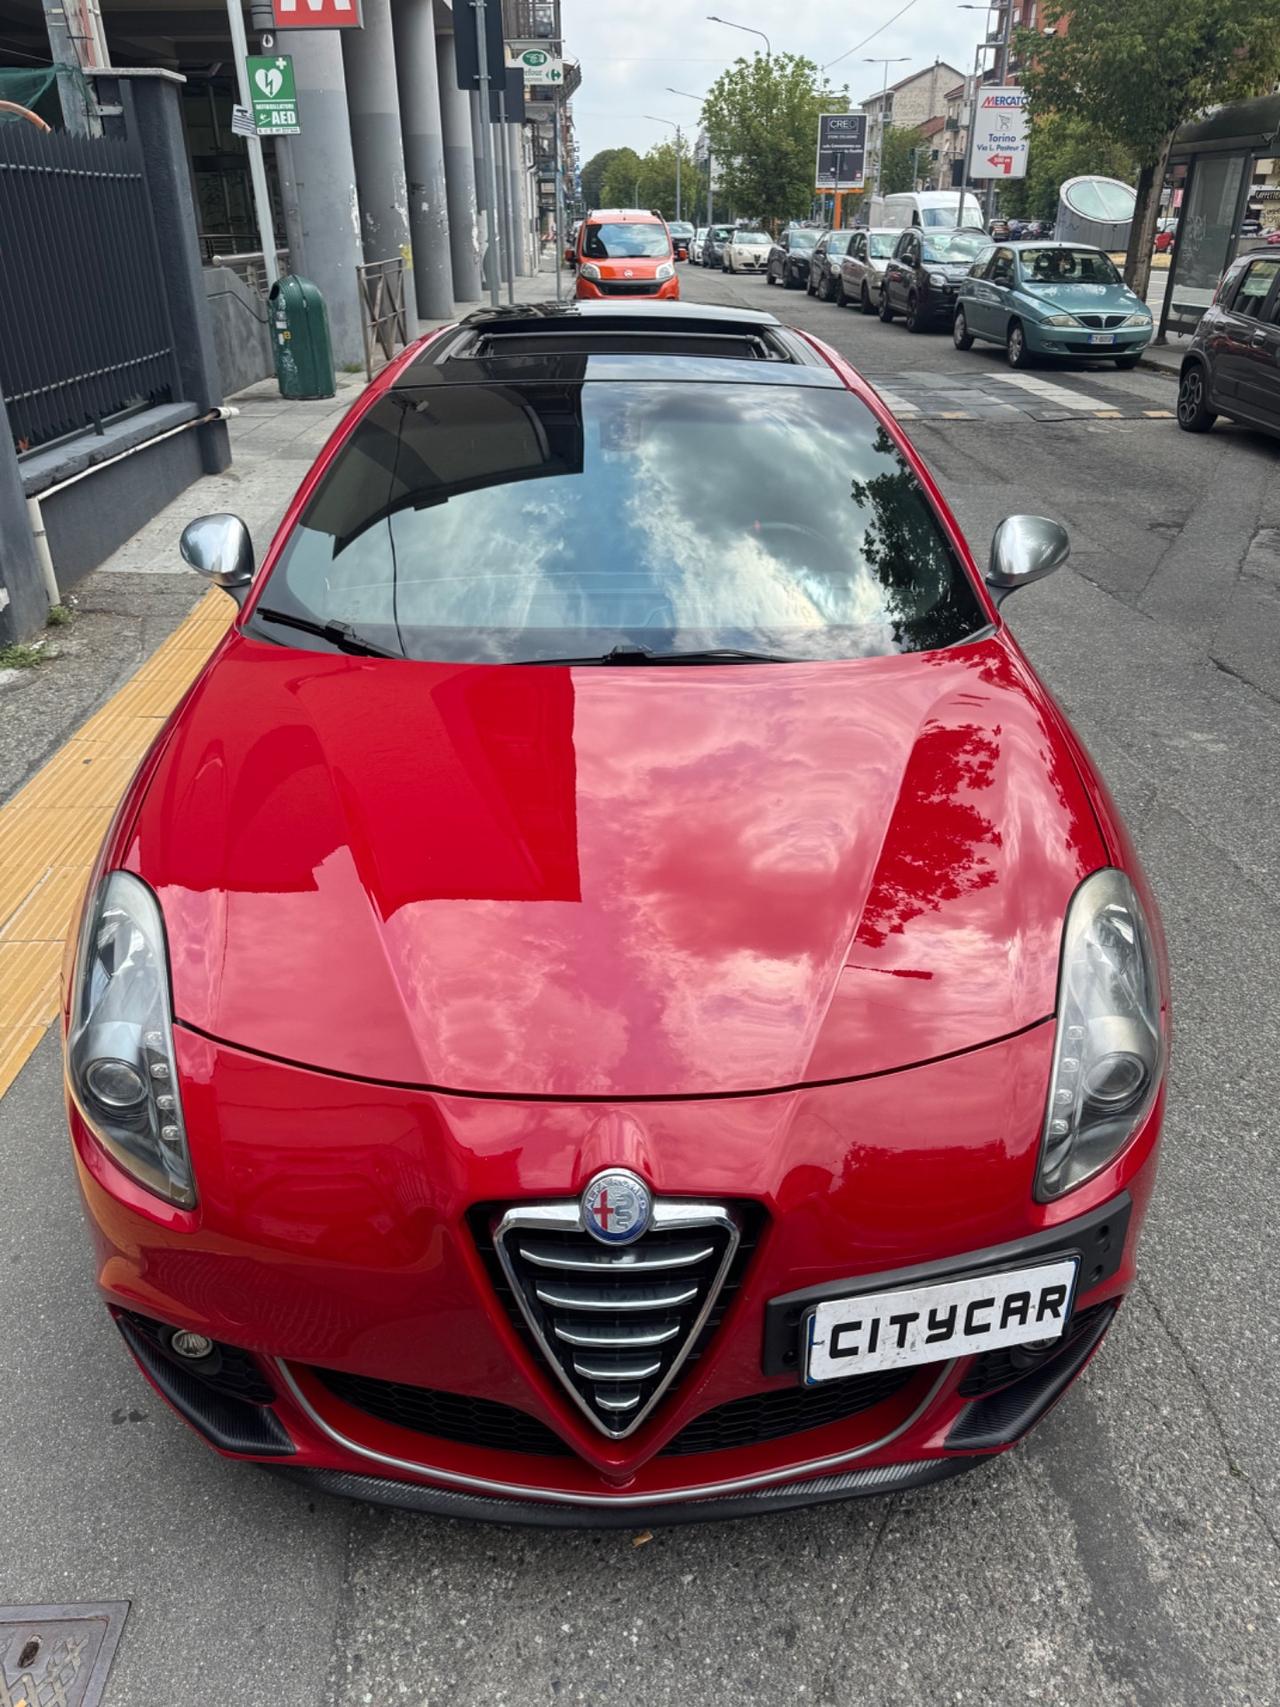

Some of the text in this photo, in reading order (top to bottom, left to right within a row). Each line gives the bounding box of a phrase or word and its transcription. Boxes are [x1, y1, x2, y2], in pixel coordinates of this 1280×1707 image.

[981, 96, 1030, 107] MERCATO
[271, 111, 296, 125] AED
[830, 120, 856, 129] CREO
[988, 133, 1017, 142] Torino
[585, 1181, 608, 1211] ALFA
[829, 1283, 1068, 1359] CITYCAR
